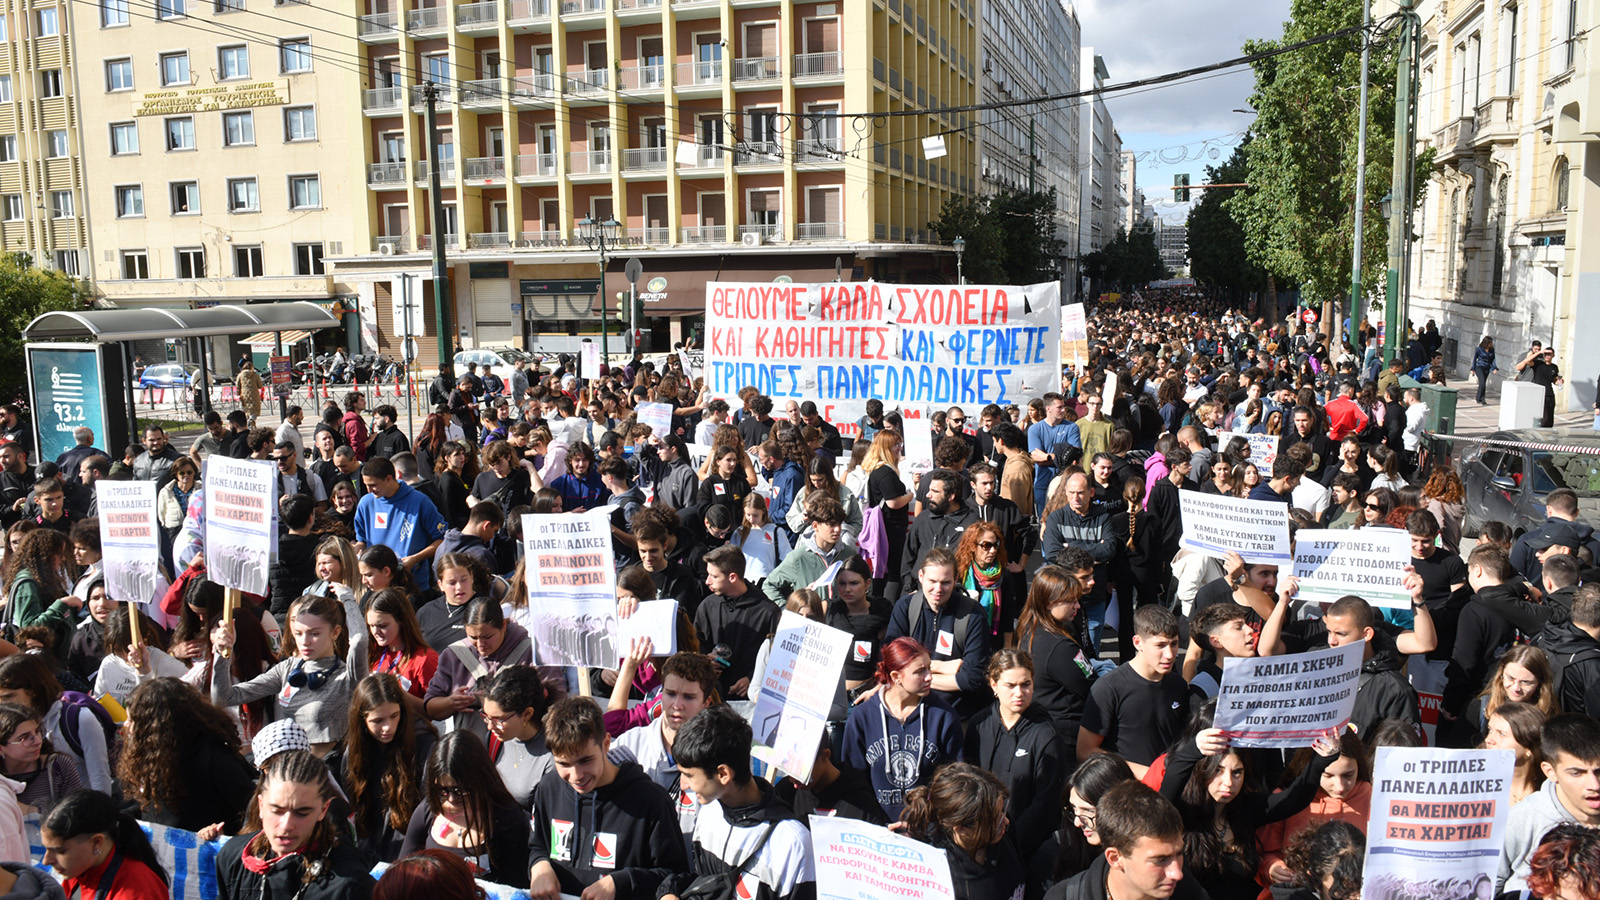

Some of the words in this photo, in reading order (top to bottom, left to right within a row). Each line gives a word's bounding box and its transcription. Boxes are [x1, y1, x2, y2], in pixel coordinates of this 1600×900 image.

[204, 103, 220, 111] ΚΑΙ
[226, 96, 284, 109] ΚΑΤΑΡΤΙΣΗΣ
[212, 89, 276, 103] ΤΟΥΡΙΣΤΙΚΗΣ
[712, 287, 807, 320] ΘΕΛΟΥΜΕ
[820, 284, 883, 321] ΚΑΛΑ
[896, 288, 1008, 325] ΣΧΟΛΕΙΑ
[712, 326, 743, 357] ΚΑΙ
[756, 326, 889, 360] ΚΑΘΗΓΗΤΕΣ
[901, 328, 935, 361] ΚΑΙ
[948, 326, 1050, 365] ΦΕΡΝΕΤΕ
[712, 361, 803, 398] ΤΡΙΠΛΕΣ
[818, 364, 1012, 404] ΠΑΝΕΛΛΑΔΙΚΕΣ
[54, 402, 86, 422] 93.2
[226, 466, 258, 478] ΤΡΙΠΛΕΣ
[112, 487, 142, 496] ΤΡΙΠΛΕΣ
[210, 477, 267, 493] ΠΑΝΕΛΛΑΔΙΚΕΣ
[100, 500, 152, 509] ΠΑΝΕΛΛΑΔΙΚΕΣ
[224, 494, 262, 508] ΜΕΙΝΟΥΝ
[115, 513, 148, 522] ΜΕΙΝΟΥΝ
[227, 509, 262, 522] ΧΑΡΤΙΑ!
[1182, 506, 1196, 514] ΟΛΑ
[1206, 511, 1224, 520] ΚΕΝΑ
[1225, 514, 1286, 526] ΕΚΠΑΙΔΕΥΤΙΚΩΝ!
[1234, 506, 1248, 514] ΕΔΩ
[1264, 509, 1284, 517] ΤΩΡΑ
[120, 527, 150, 537] ΧΑΡΤΙΑ!
[540, 525, 548, 534] ΟΙ
[550, 522, 591, 534] ΤΡΠΛΕΣ
[1194, 524, 1218, 535] ΚΑΜΙΑ
[1220, 529, 1276, 542] ΣΥΓΧΩΝΕΥΣΗ
[1206, 535, 1243, 548] ΜΑΘΗΤΕΣ
[1251, 542, 1274, 550] ΤΑΞΗ
[1314, 540, 1374, 552] ΣΥΓΧΡΟΝΕΣ
[1376, 546, 1390, 554] ΚΑΙ
[540, 558, 552, 568] ΘΑ
[554, 555, 602, 568] ΜΕΙΝΟΥΝ
[1296, 554, 1346, 566] ΑΣΦΑΛΕΙΣ
[1349, 558, 1408, 570] ΥΠΟΔΟΜΕΣ
[542, 576, 558, 584] ΣΤΑ
[560, 572, 603, 585] ΧΑΡΤΙΑ!
[1298, 570, 1314, 578] ΓΙΑ
[1317, 570, 1338, 581] ΟΛΑ
[1341, 573, 1354, 582] ΤΑ
[805, 624, 822, 638] ΟΧΙ
[1254, 662, 1298, 677] ΚΑΜΙΑ
[1302, 654, 1344, 673] ΣΚΕΨΗ
[766, 677, 778, 690] ΟΧΙ
[1223, 685, 1240, 694] ΓΙΑ
[1243, 682, 1292, 694] ΑΠΟΒΟΛΗ
[1294, 680, 1312, 690] ΚΑΙ
[1314, 668, 1360, 688] ΚΑΤΑΣΤΟΛΗ
[1230, 701, 1243, 710] ΣΕ
[1246, 698, 1296, 710] ΜΑΘΗΤΕΣ
[1298, 696, 1316, 707] ΚΑΙ
[1318, 688, 1350, 705] ΣΧΟΛΕΙΑ
[1246, 716, 1268, 724] ΠΟΥ
[1270, 710, 1338, 724] ΑΓΩΝΙΖΟΝΤΑΙ!
[1403, 762, 1416, 772] ΟΙ
[1420, 759, 1486, 774] ΤΡΙΠΛΕΣ
[1380, 779, 1503, 794] ΠΑΝΕΛΛΑΔΙΚΕΣ
[1392, 805, 1409, 816] ΘΑ
[1414, 802, 1492, 818] ΜΕΙΝΟΥΝ
[1390, 828, 1416, 838] ΣΤΑ
[1420, 824, 1488, 840] ΧΑΡΤΙΑ!
[844, 834, 878, 850] ΔΩΣΤΕ
[880, 844, 920, 860] ΛΕΦΤΑ
[830, 844, 845, 854] ΝΑ
[848, 846, 889, 866] ΕΧΟΥΜΕ
[844, 871, 862, 880] ΚΑΙ
[864, 876, 924, 899] ΤΑΜΠΟΥΡΑ!
[882, 870, 950, 896] ΚΑΘΗΓΗΤΕΣ
